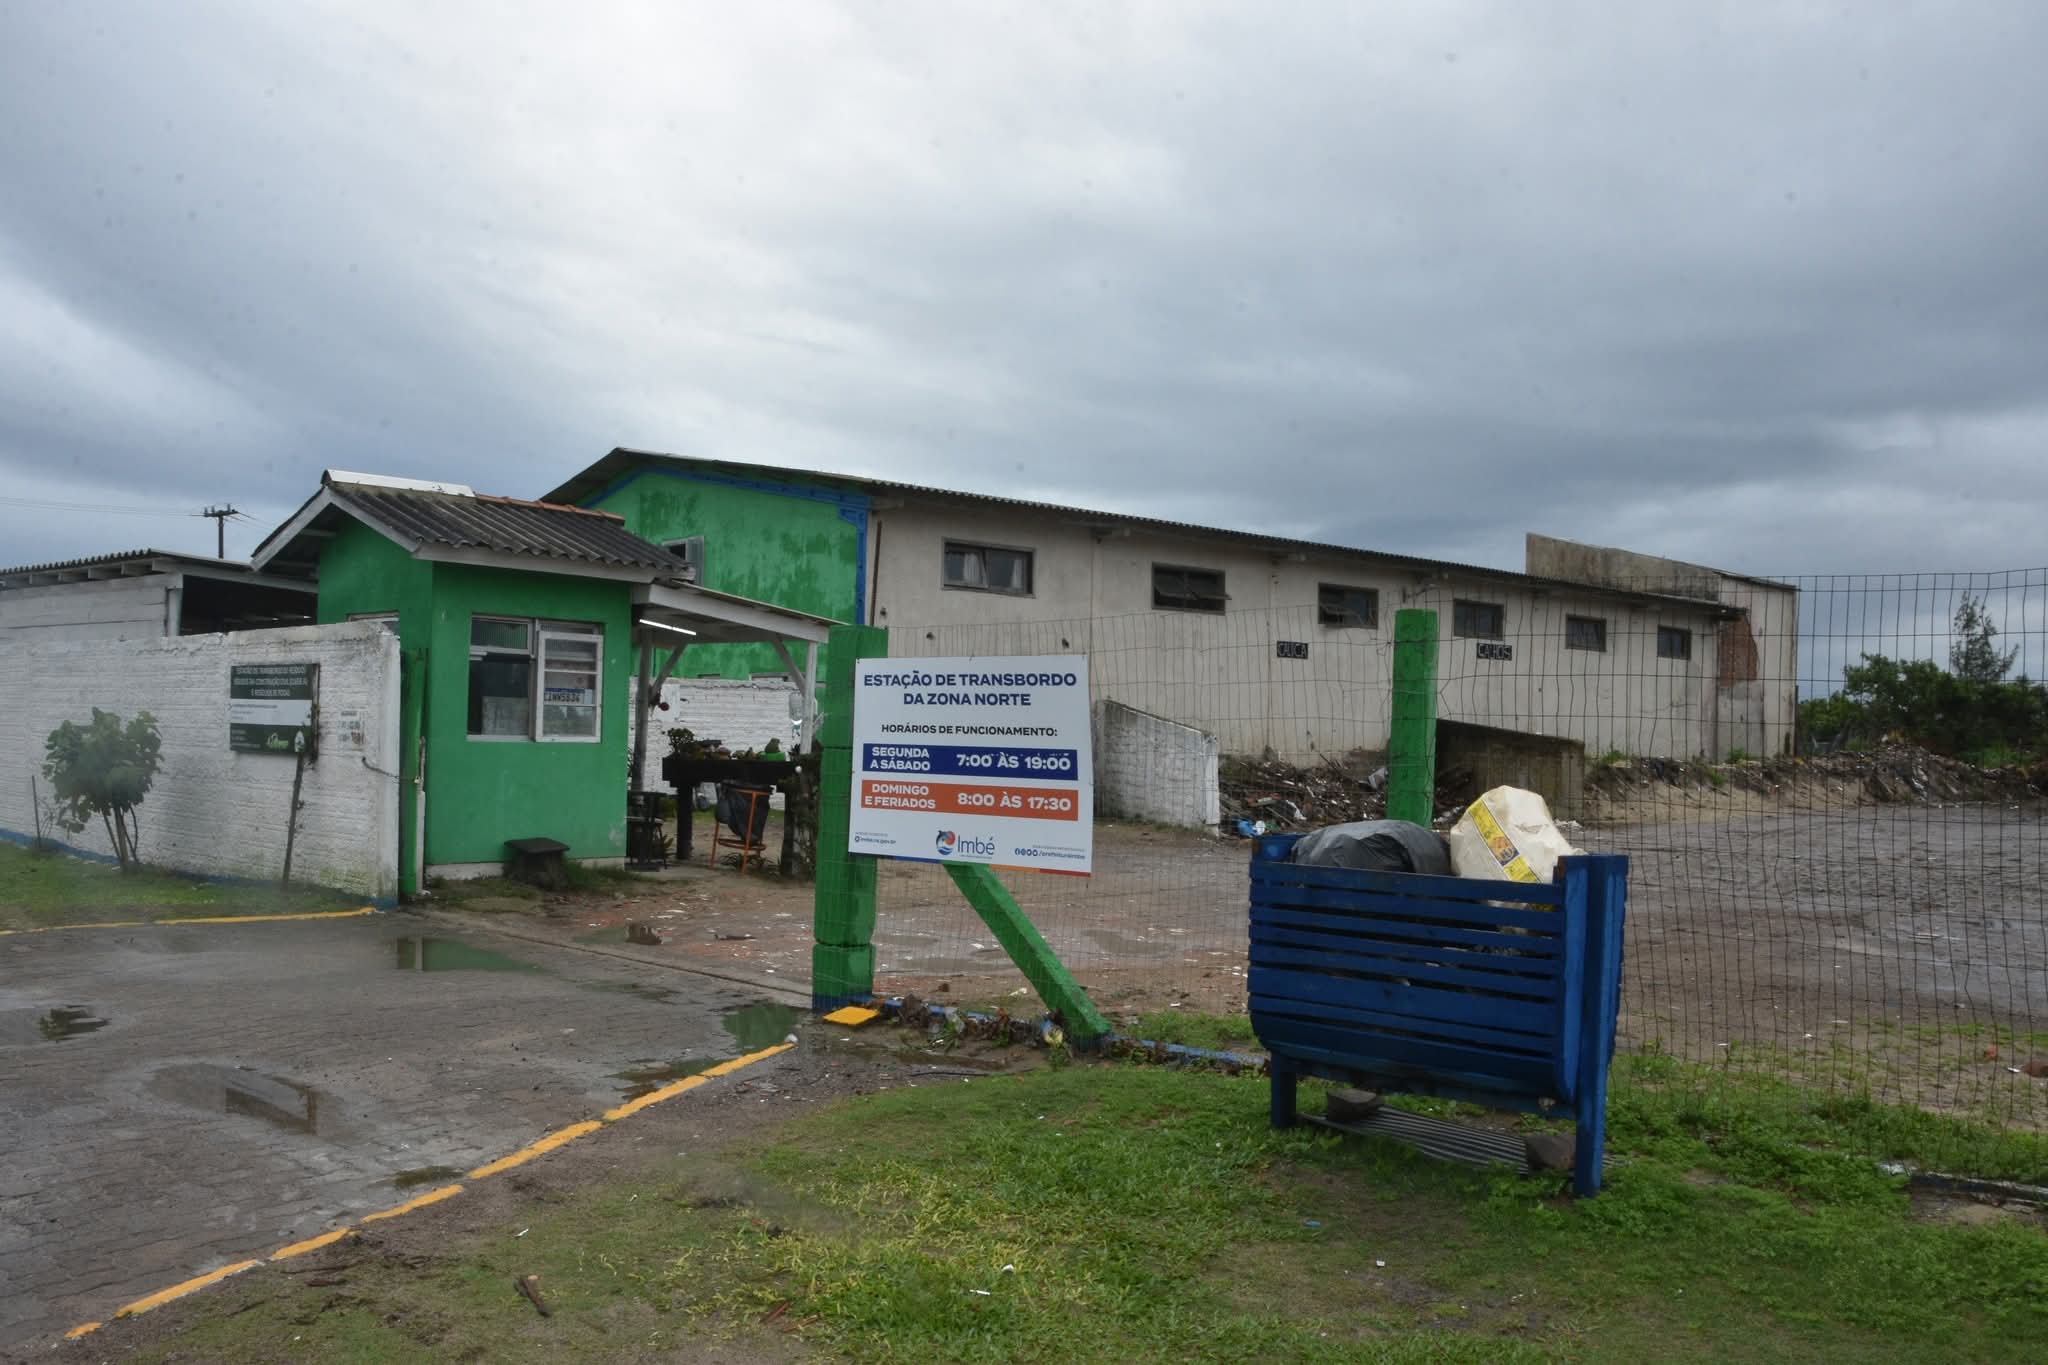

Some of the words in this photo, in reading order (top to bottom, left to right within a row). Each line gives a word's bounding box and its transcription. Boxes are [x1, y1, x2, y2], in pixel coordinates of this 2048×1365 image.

[864, 670, 932, 688] ESTAÇÃO
[936, 675, 956, 686] DE
[959, 673, 1077, 686] TRANSBORDO
[904, 693, 924, 705] DA
[927, 693, 971, 705] ZONA
[975, 693, 1031, 706] NORTE
[882, 723, 937, 734] HORÁRIOS
[939, 725, 953, 734] DE
[955, 725, 1058, 737] FUNCIONAMENTO:
[872, 747, 930, 758] SEGUNDA
[870, 760, 879, 769] A
[880, 758, 931, 770] SÁBADO
[956, 754, 992, 767] 7:00
[997, 752, 1019, 768] ÀS
[1024, 756, 1071, 770] 19:00
[872, 784, 929, 795] DOMINGO
[865, 796, 873, 805] E
[874, 797, 936, 809] FERIADOS
[957, 793, 995, 806] 8:00
[1000, 792, 1022, 808] ÀS
[1027, 797, 1072, 811] 17:30
[957, 835, 995, 855] Imbé
